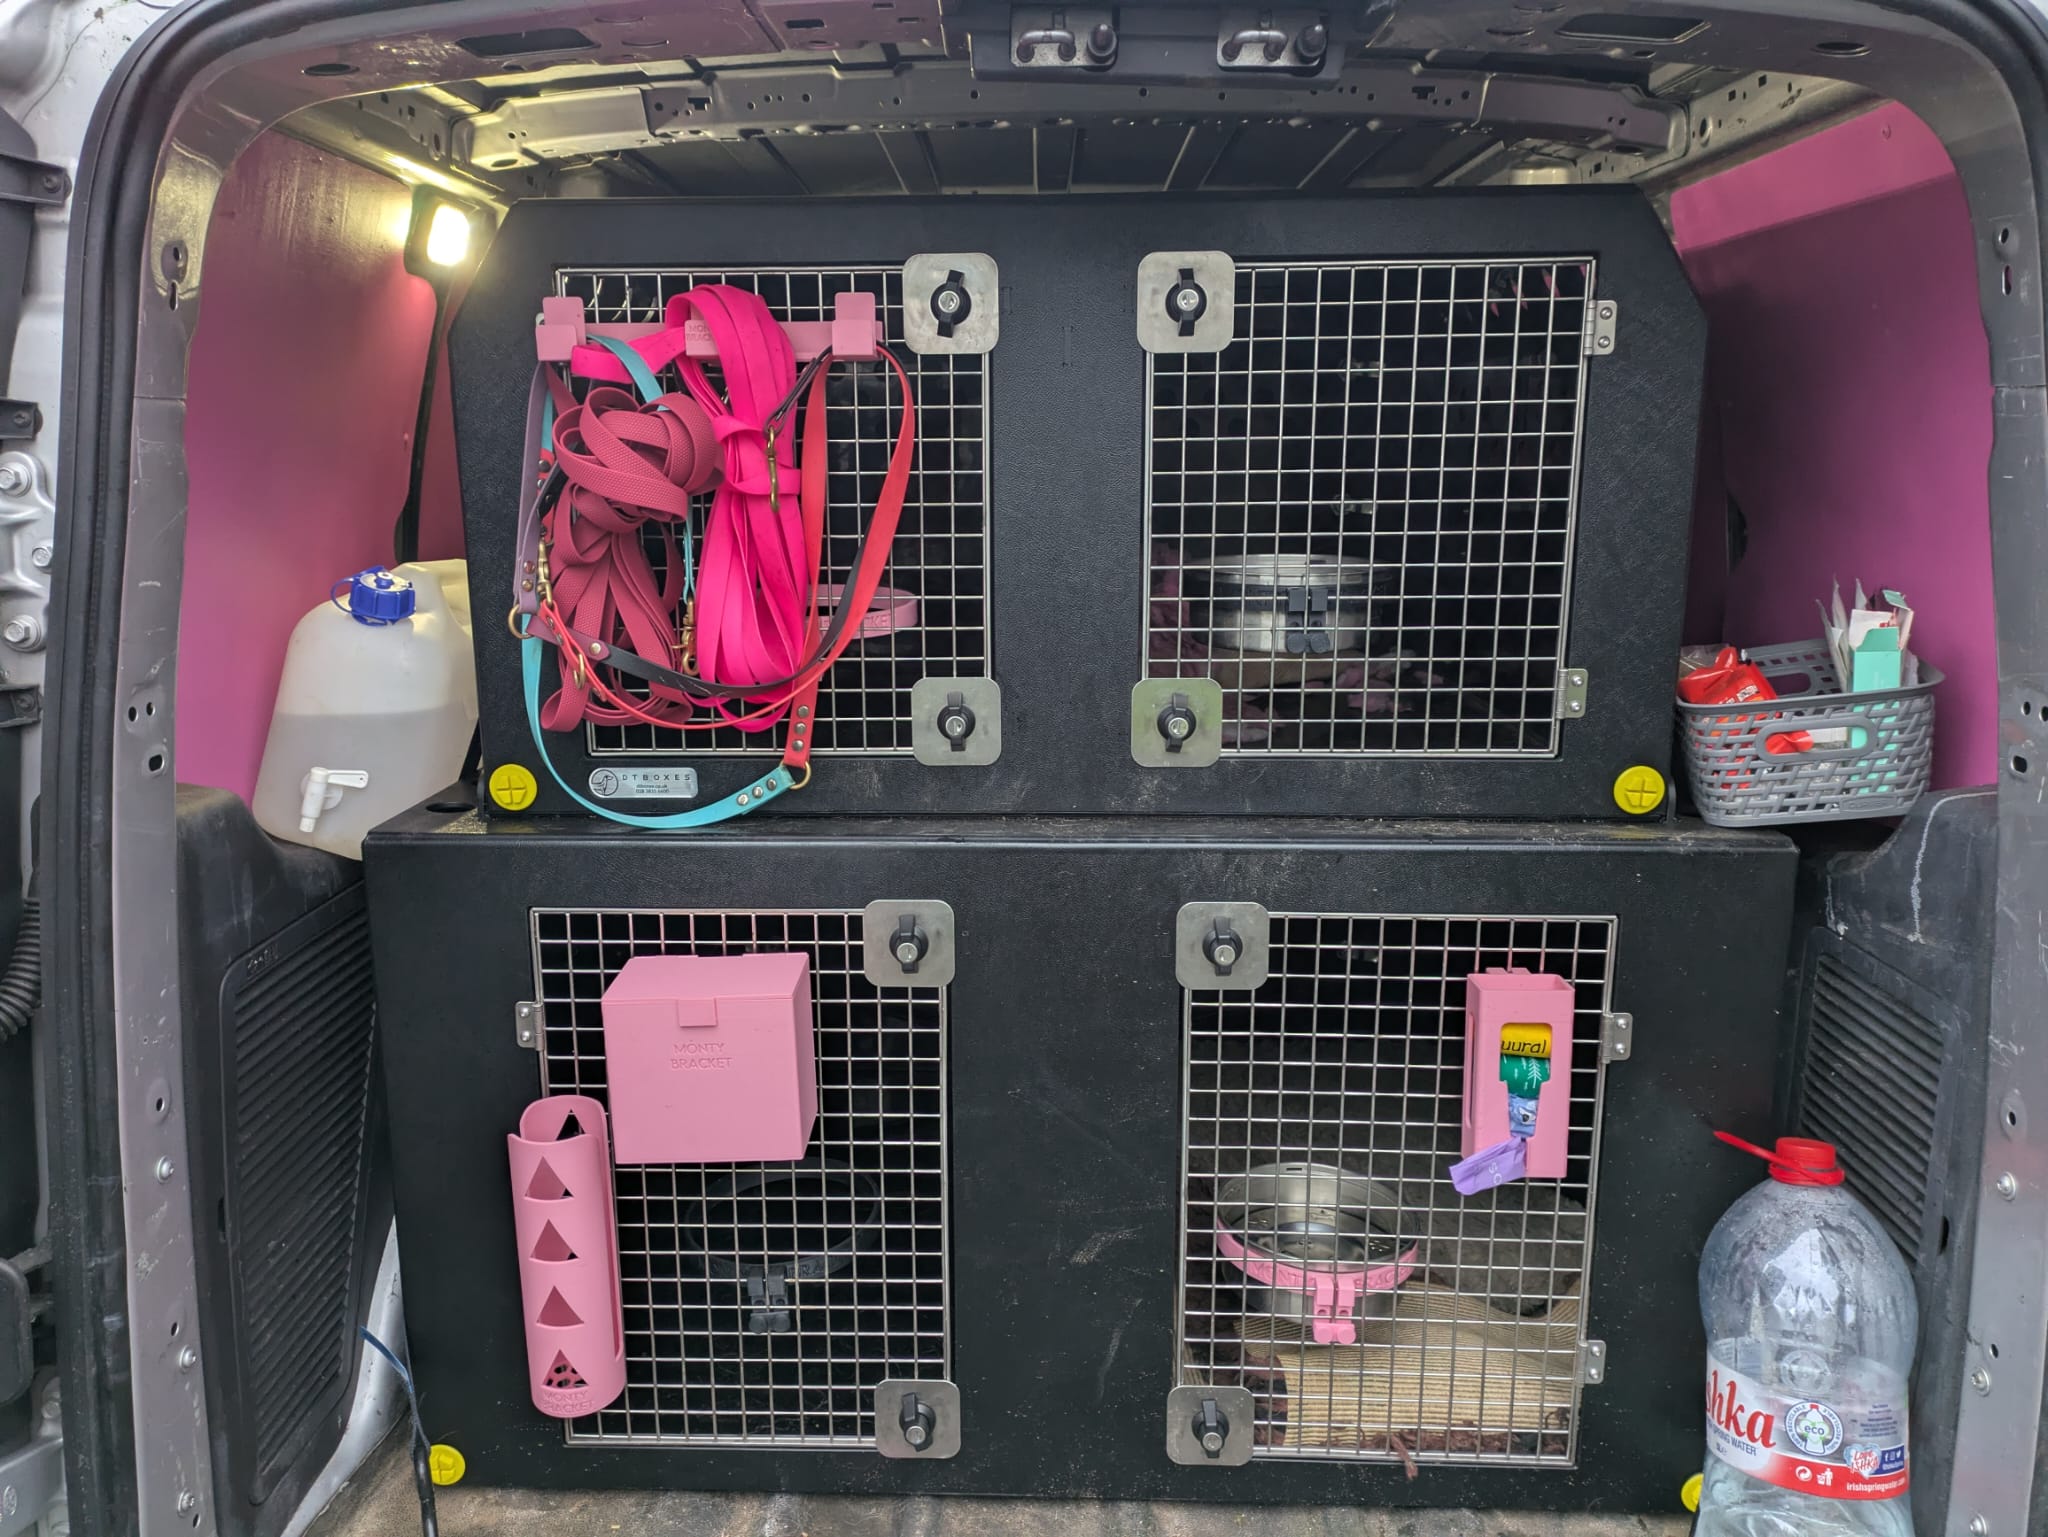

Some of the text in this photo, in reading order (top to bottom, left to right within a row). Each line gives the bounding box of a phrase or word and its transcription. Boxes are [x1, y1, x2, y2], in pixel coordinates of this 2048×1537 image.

[673, 1042, 725, 1054] MONTY
[671, 1057, 733, 1069] BRACKET
[1804, 1425, 1825, 1435] eco
[1731, 1436, 1757, 1457] WATER
